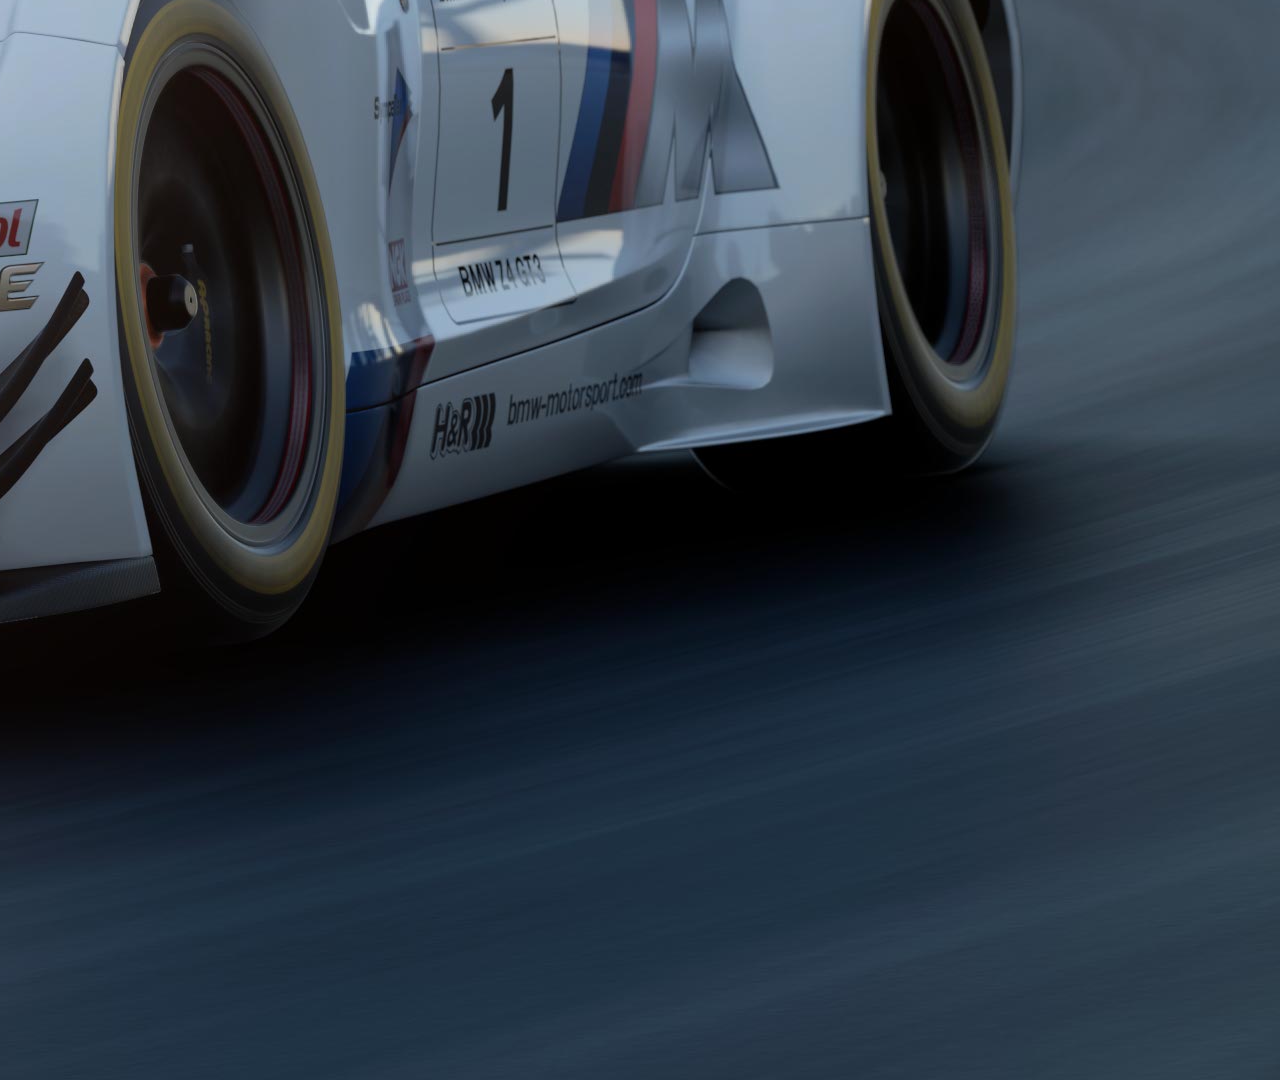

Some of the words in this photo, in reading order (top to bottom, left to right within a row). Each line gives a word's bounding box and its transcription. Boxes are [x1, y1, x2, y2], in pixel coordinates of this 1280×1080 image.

[490, 68, 514, 212] 1
[457, 262, 497, 297] BMW
[495, 258, 516, 291] Z4
[515, 253, 547, 287] GT3
[507, 372, 644, 425] bmw-motorsport.com
